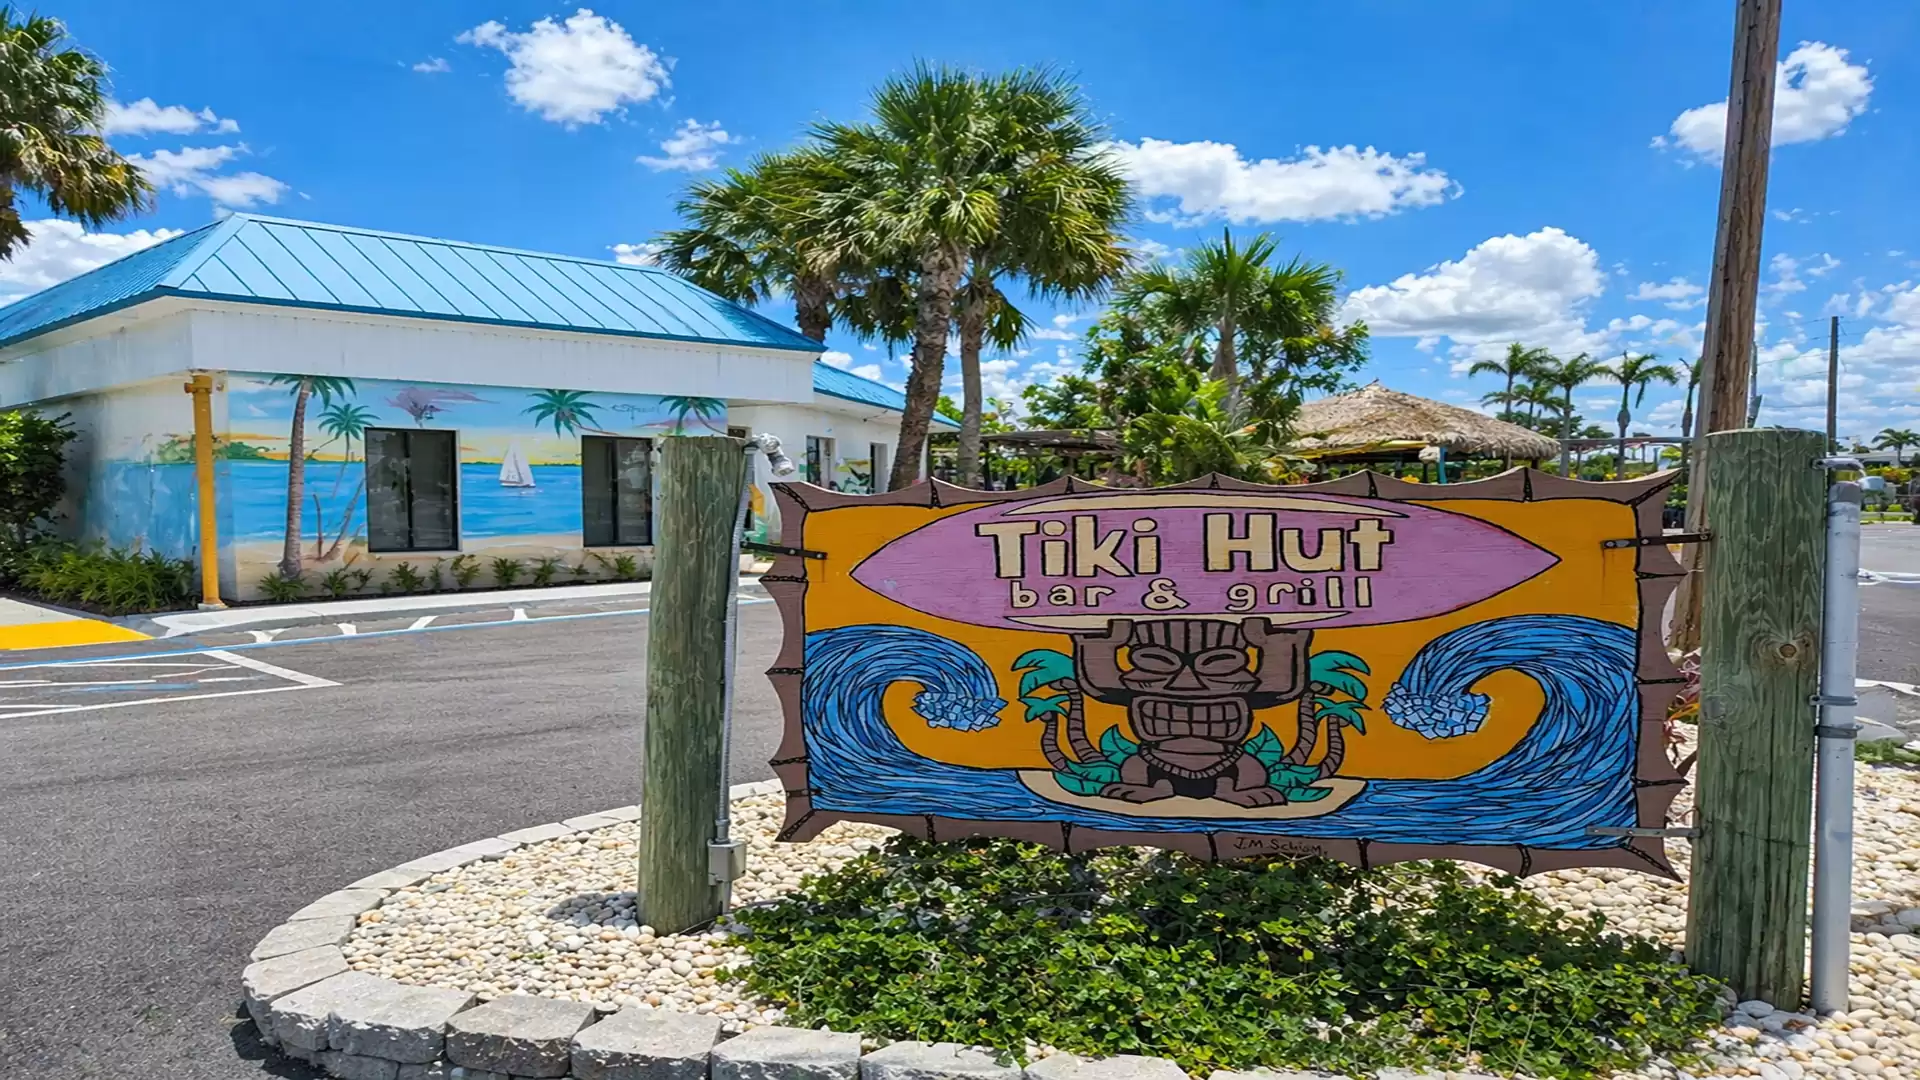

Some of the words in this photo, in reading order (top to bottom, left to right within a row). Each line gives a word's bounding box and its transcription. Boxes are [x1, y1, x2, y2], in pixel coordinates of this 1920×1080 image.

[975, 514, 1161, 578] Tiki
[1203, 513, 1395, 573] Hut
[1010, 581, 1114, 609] bar
[1144, 578, 1189, 610] &
[1226, 577, 1372, 612] grill
